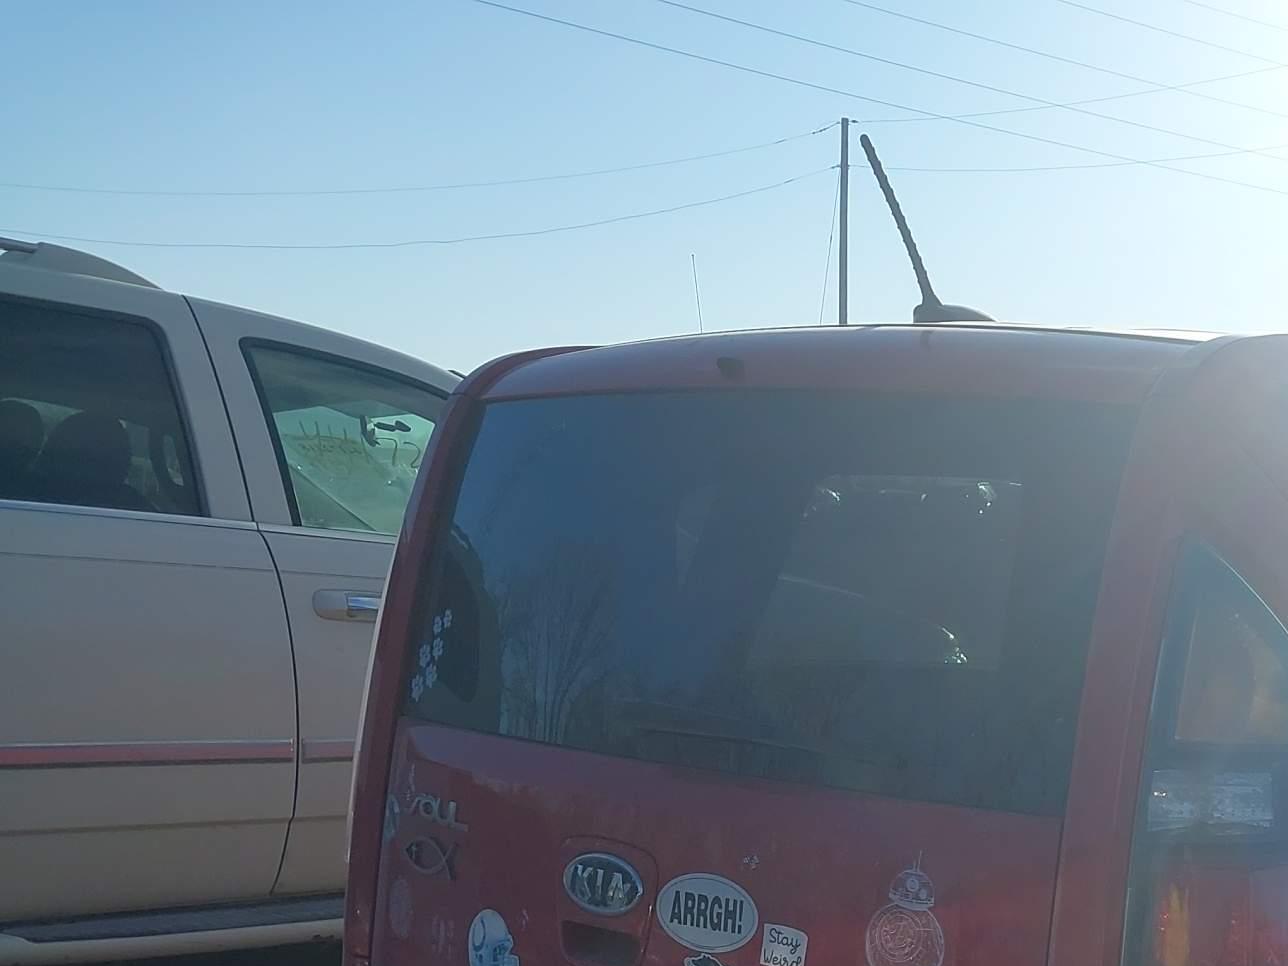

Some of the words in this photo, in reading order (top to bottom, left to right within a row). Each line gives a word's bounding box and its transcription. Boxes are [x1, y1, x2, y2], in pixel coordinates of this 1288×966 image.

[569, 863, 631, 906] KIA
[669, 889, 744, 935] ARRGH!
[768, 927, 801, 955] Stay
